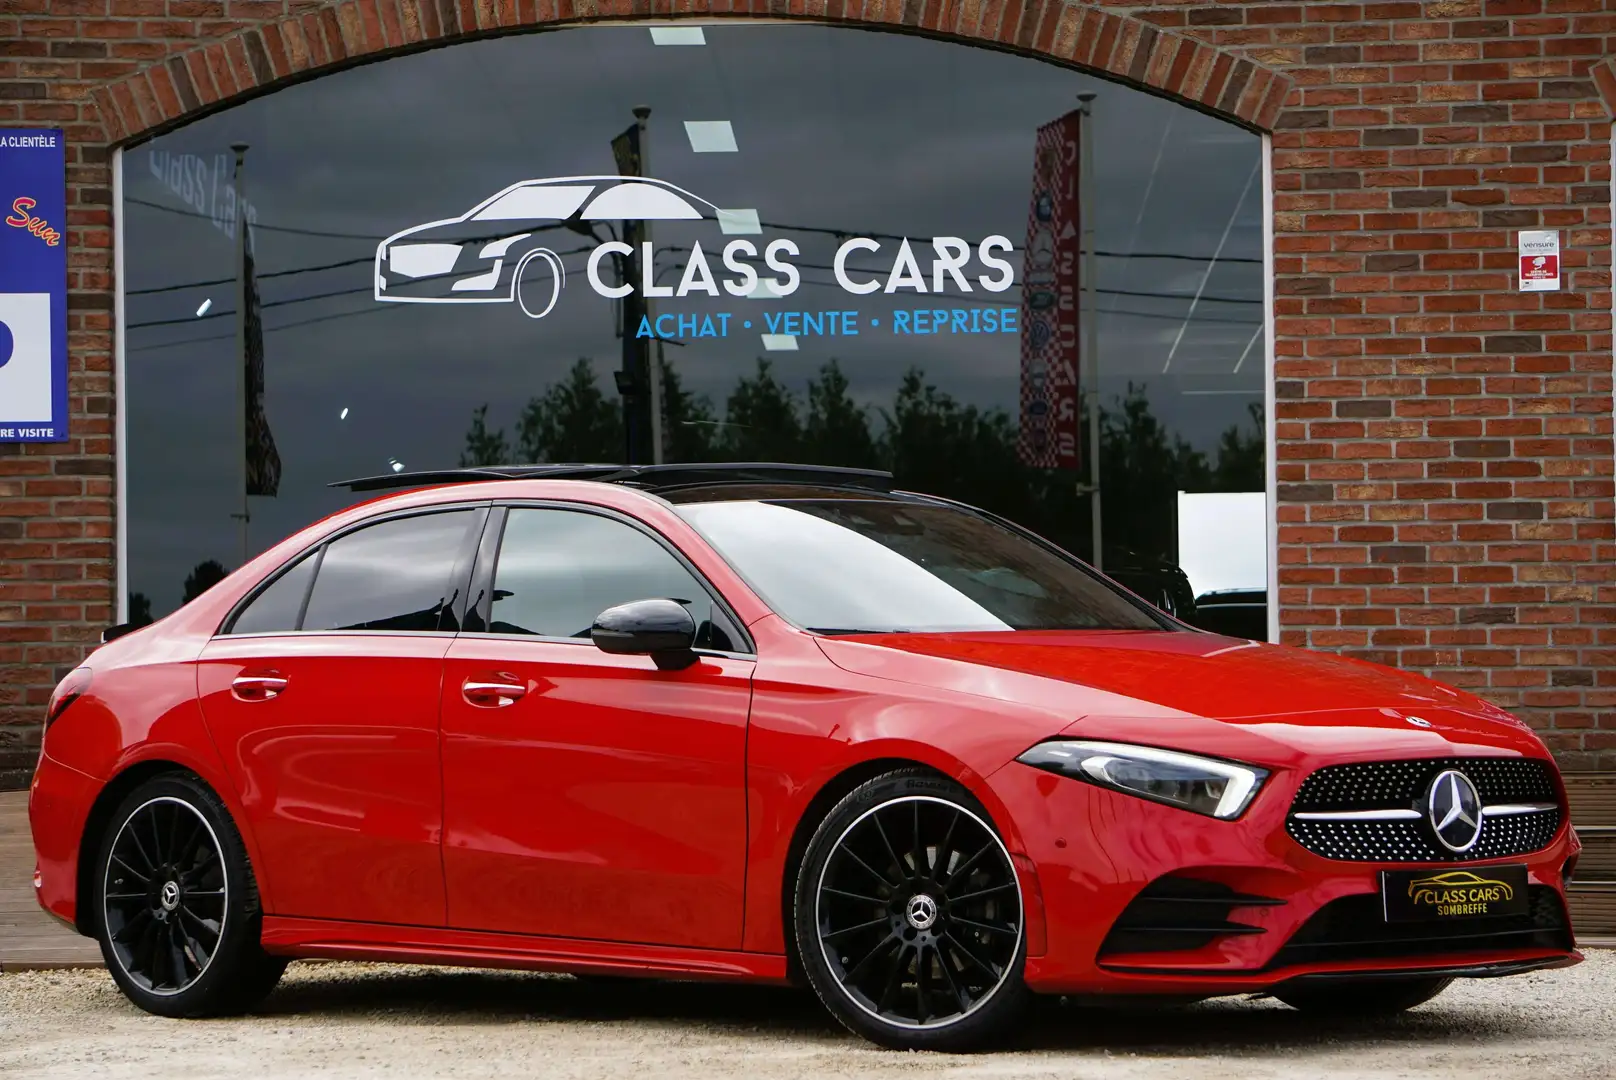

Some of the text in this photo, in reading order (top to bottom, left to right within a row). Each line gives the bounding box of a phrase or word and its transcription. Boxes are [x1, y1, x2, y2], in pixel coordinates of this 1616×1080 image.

[9, 134, 56, 148] CLIENTÈLE
[6, 196, 61, 246] Sun
[586, 235, 1015, 298] CLASS CARS
[635, 308, 1018, 338] ACHAT VENTE REPRISE
[18, 428, 54, 438] VISITE
[1424, 888, 1500, 904] CLASS CARS
[1437, 903, 1488, 916] SOMBREFFE
